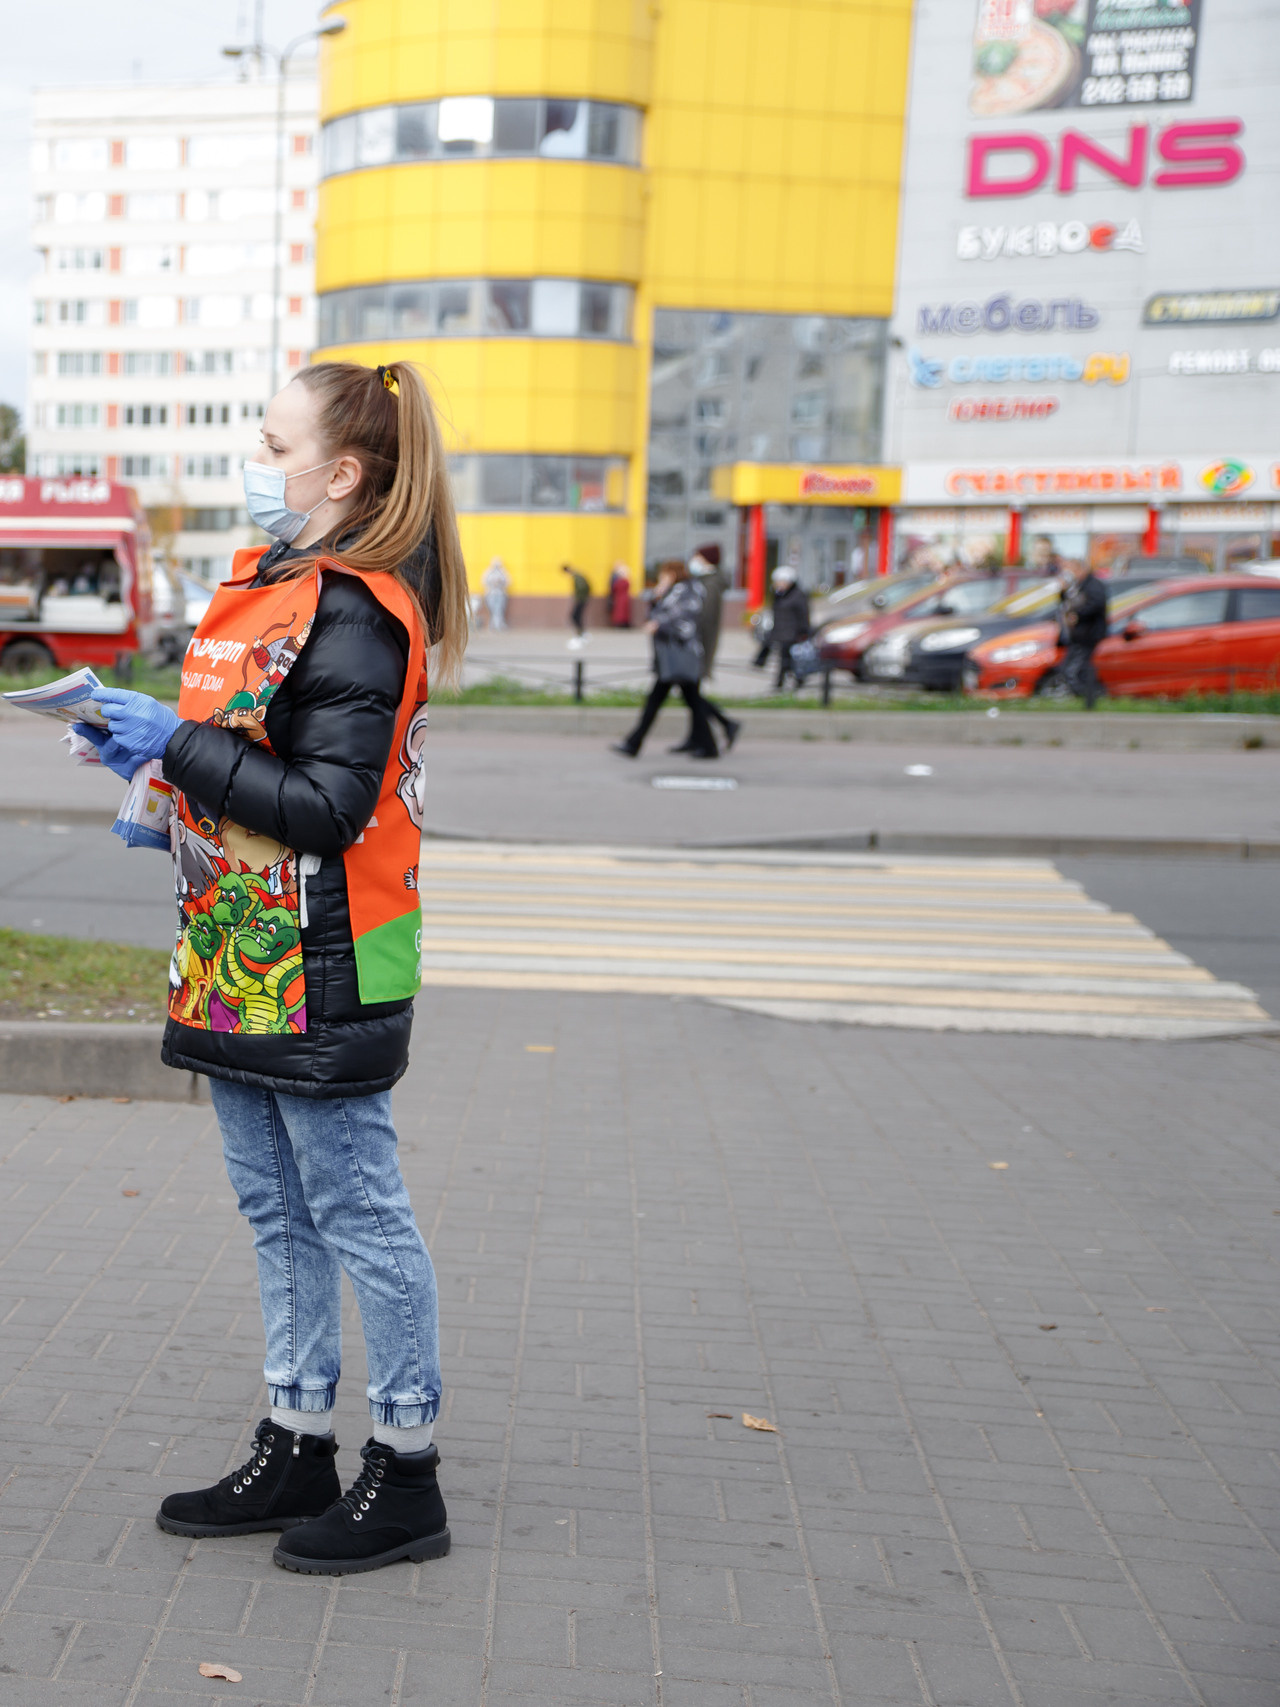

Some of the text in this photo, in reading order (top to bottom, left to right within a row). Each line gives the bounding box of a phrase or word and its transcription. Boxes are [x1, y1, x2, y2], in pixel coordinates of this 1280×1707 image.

[966, 118, 1245, 198] DNS
[1168, 349, 1250, 375] РЕМОНТ
[39, 479, 110, 503] РЫБА
